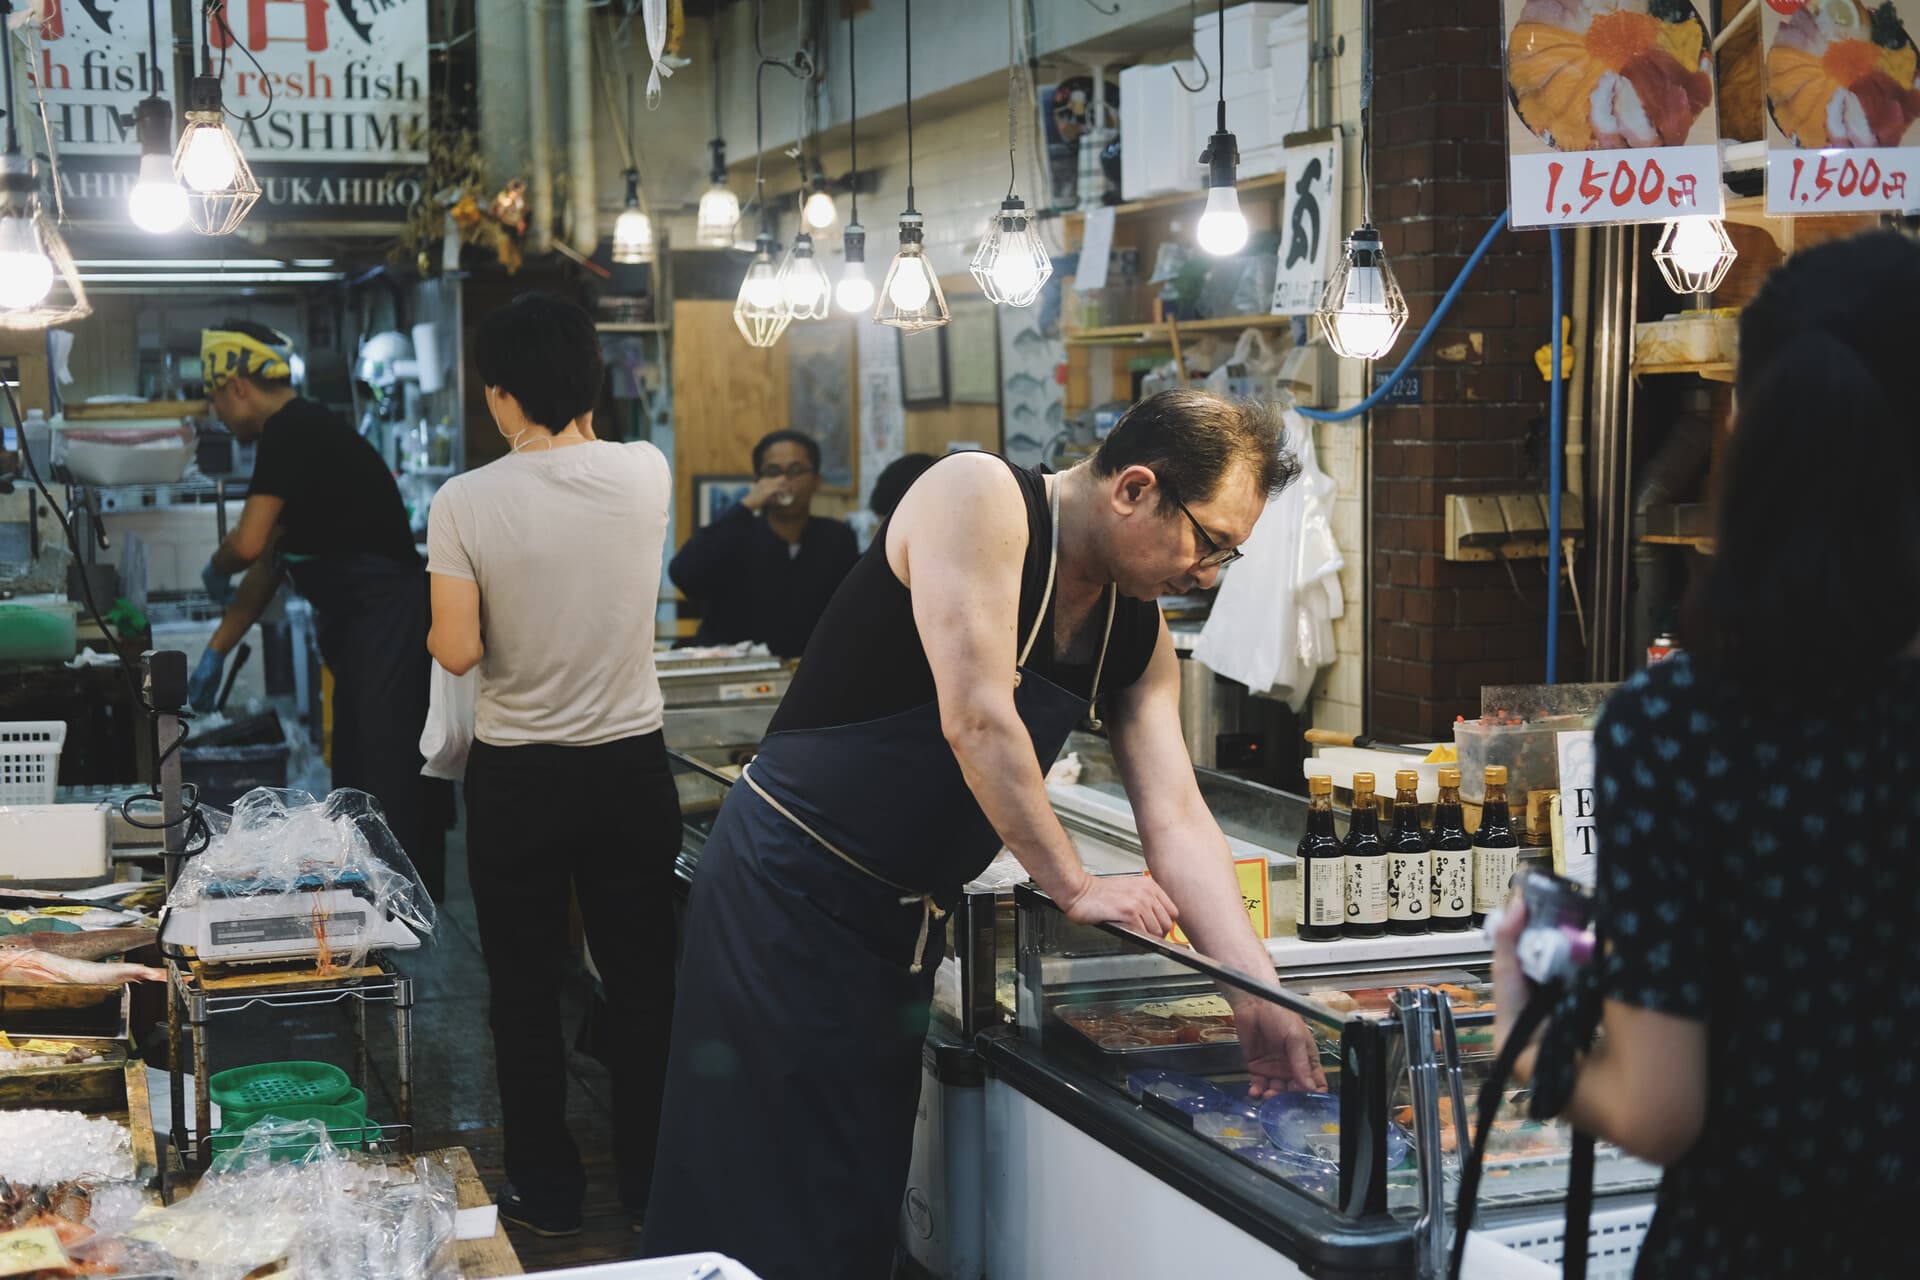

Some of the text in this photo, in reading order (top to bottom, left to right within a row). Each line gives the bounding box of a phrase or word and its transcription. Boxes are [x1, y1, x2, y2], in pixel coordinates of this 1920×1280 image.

[81, 50, 166, 92] fish
[344, 60, 420, 101] fish
[237, 108, 424, 152] ASHIMI
